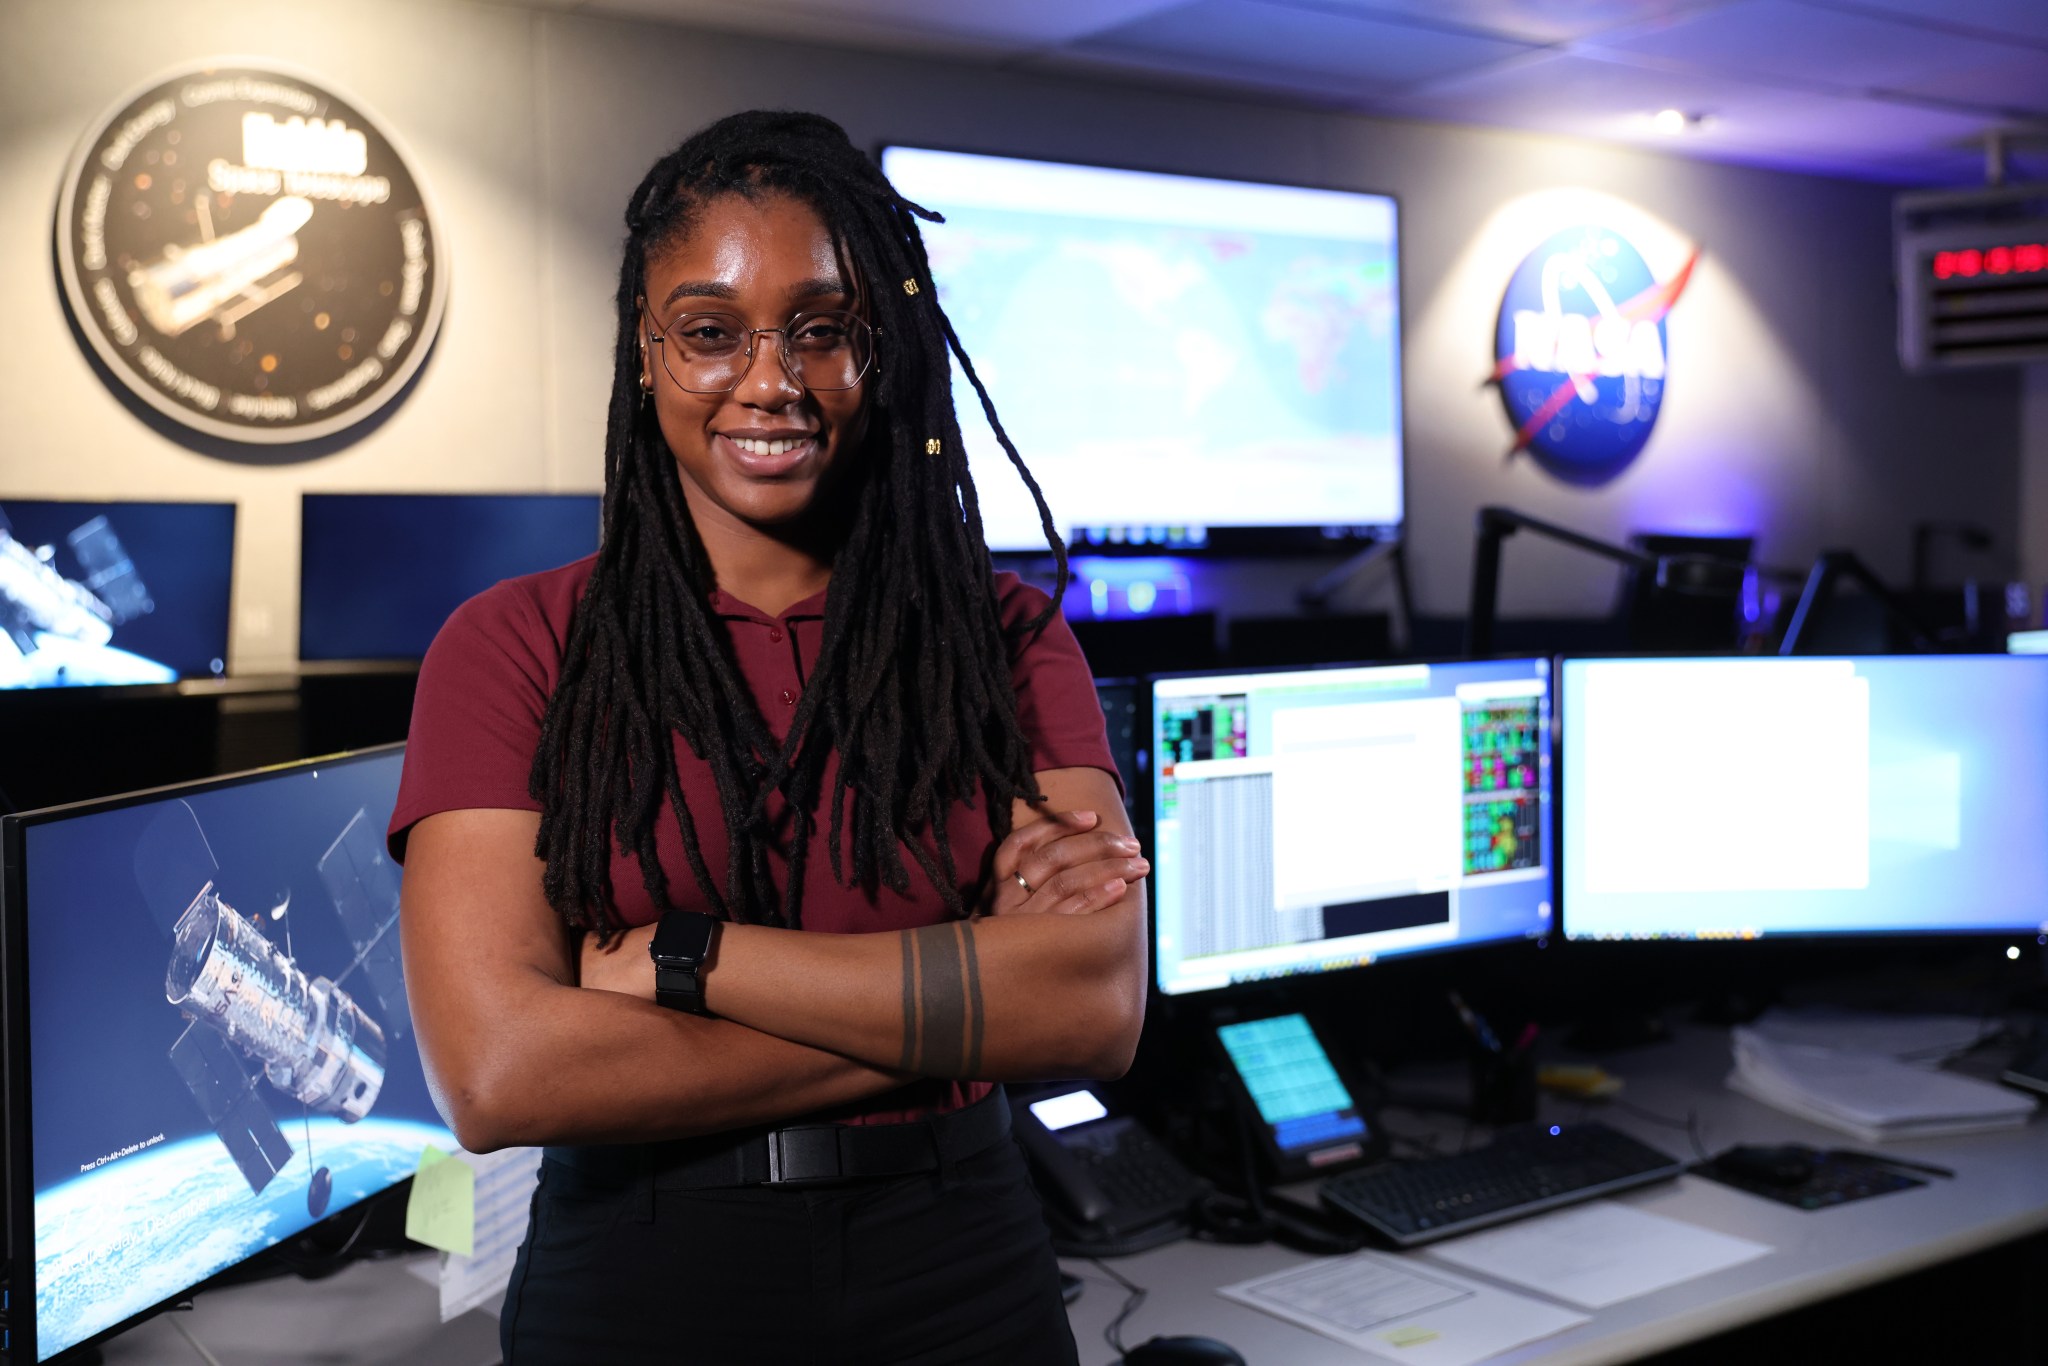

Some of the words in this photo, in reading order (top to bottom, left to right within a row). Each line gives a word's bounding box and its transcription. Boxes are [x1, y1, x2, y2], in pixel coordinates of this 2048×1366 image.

[1513, 310, 1665, 379] NASA
[81, 1161, 96, 1173] Press
[96, 1143, 139, 1167] Ctrl+Alt+Delete
[140, 1141, 146, 1149] to
[146, 1132, 166, 1147] unlock.
[145, 1196, 213, 1237] December
